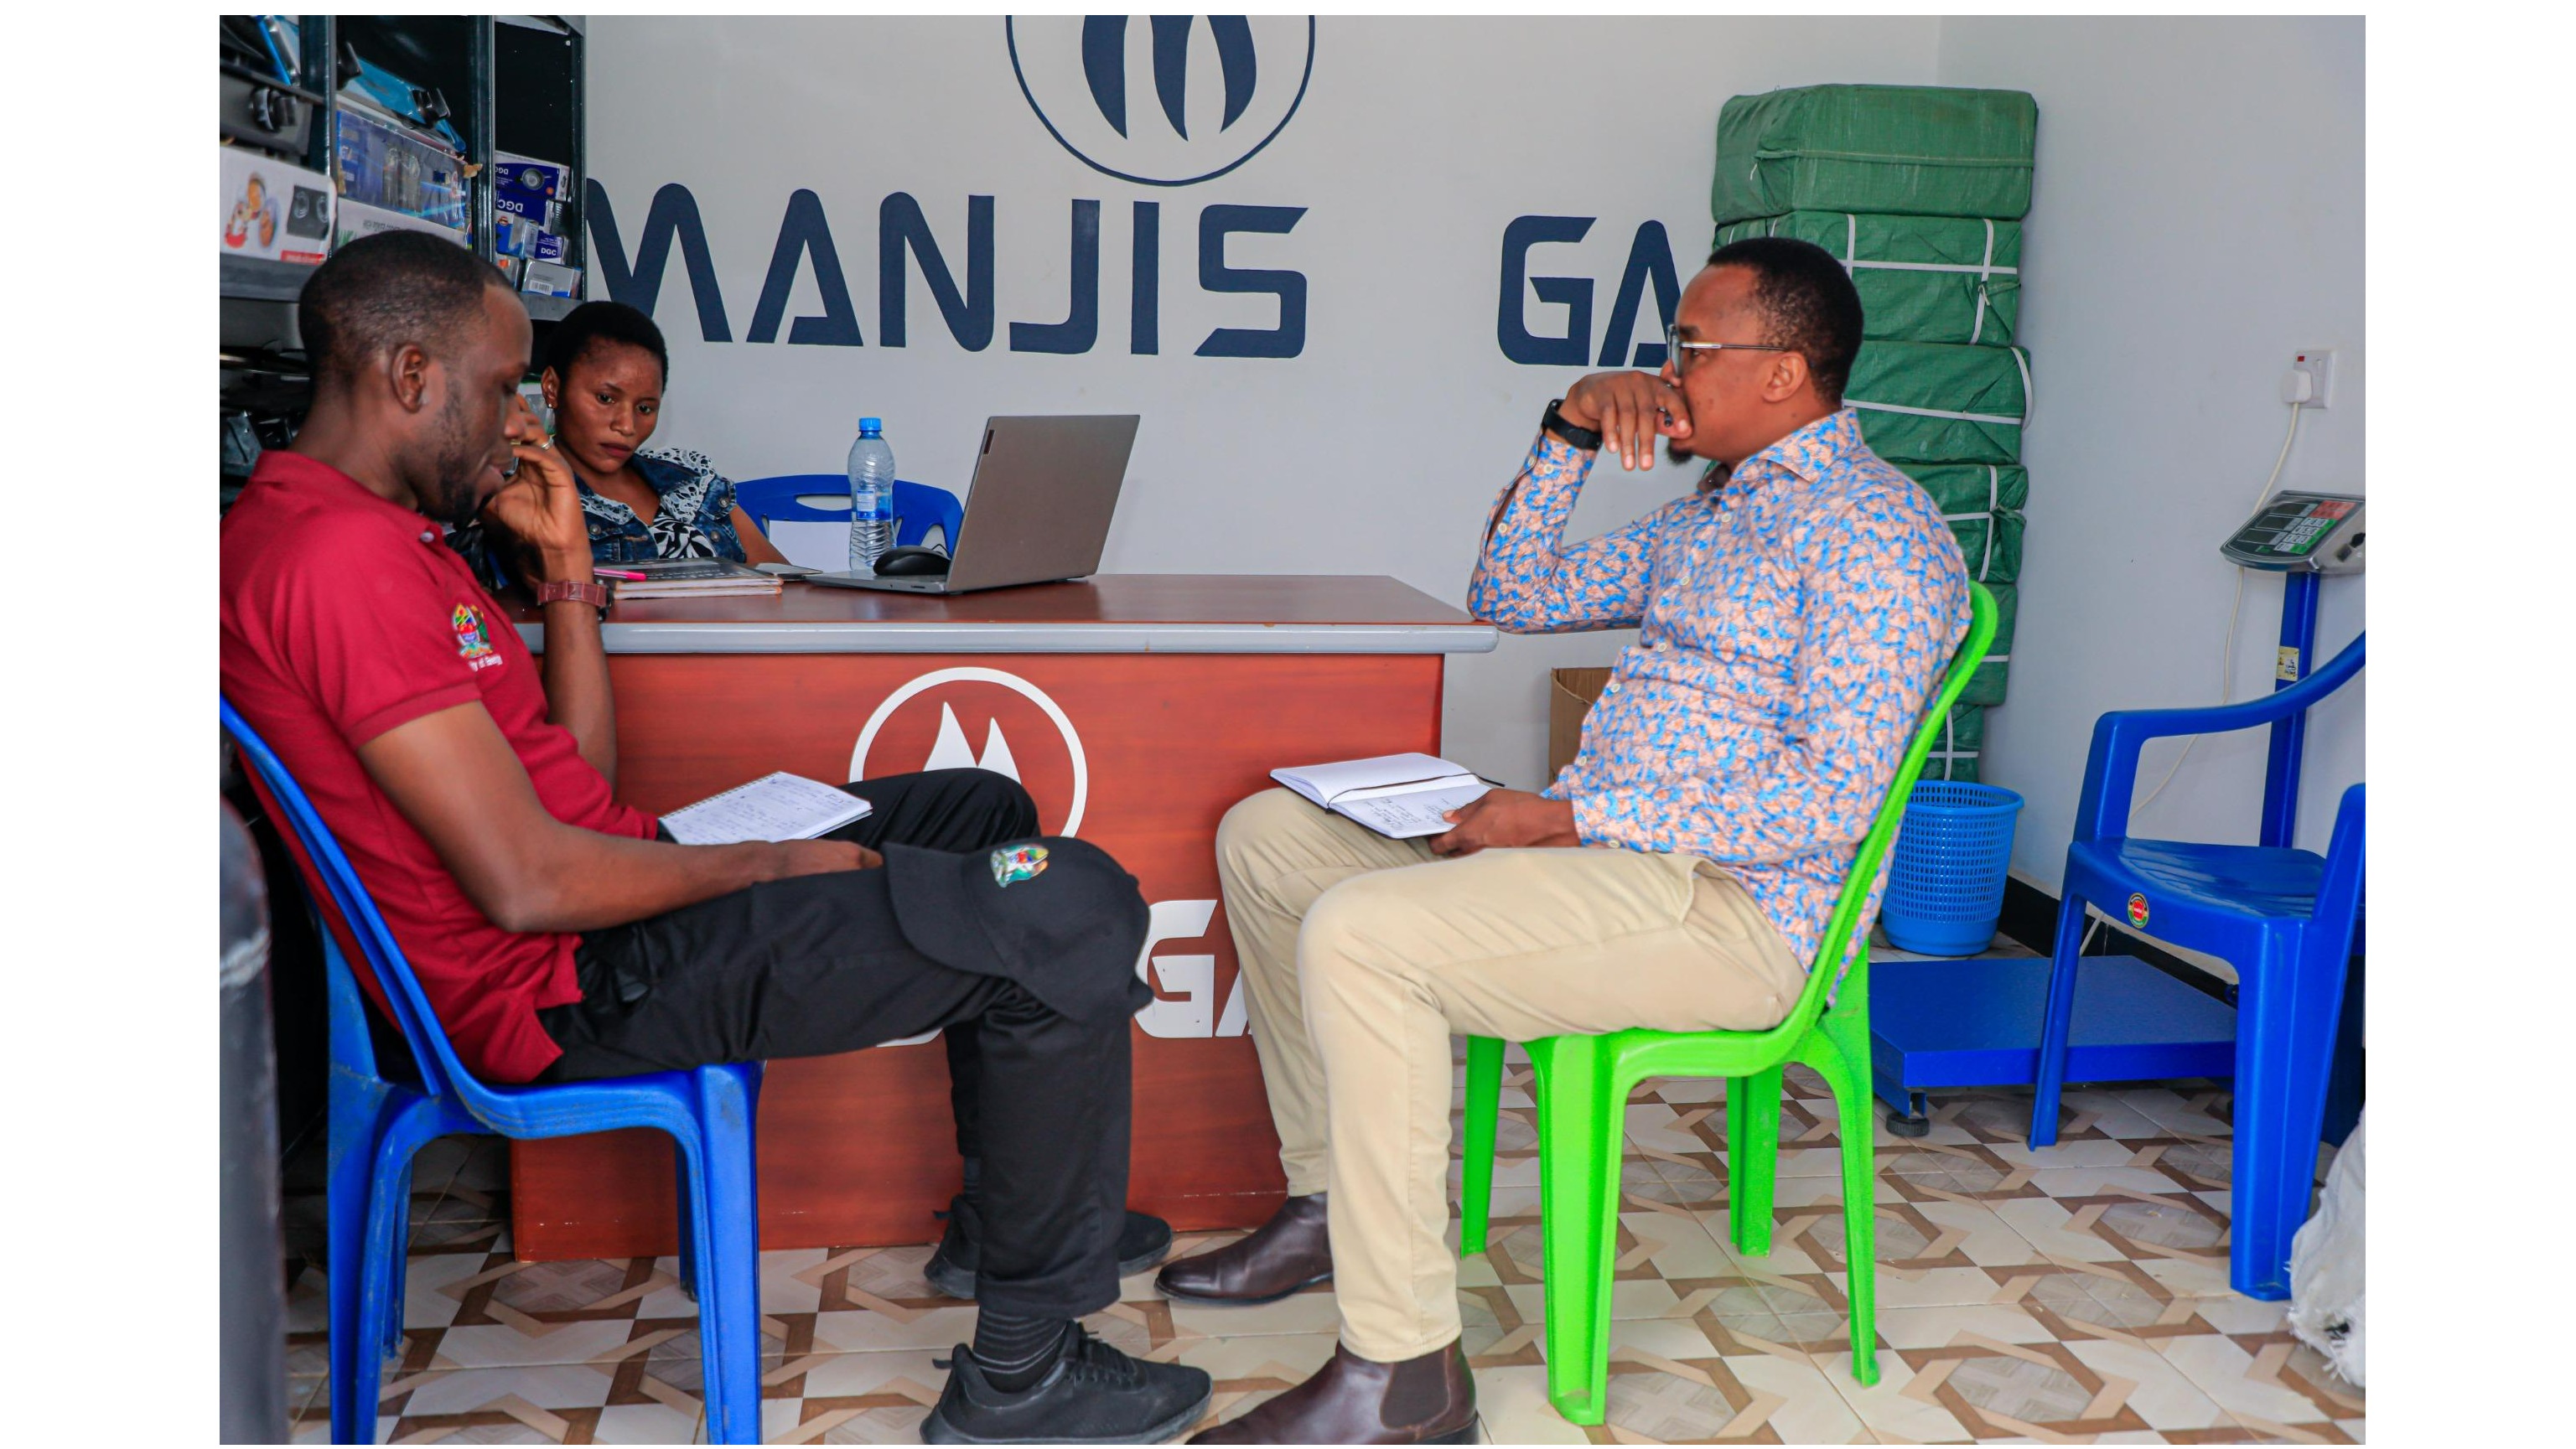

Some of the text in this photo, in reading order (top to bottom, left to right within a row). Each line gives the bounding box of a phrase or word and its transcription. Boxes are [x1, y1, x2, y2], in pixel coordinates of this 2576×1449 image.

[497, 199, 523, 213] DGC
[541, 247, 557, 256] DGC
[586, 178, 1682, 367] MANJIS GA
